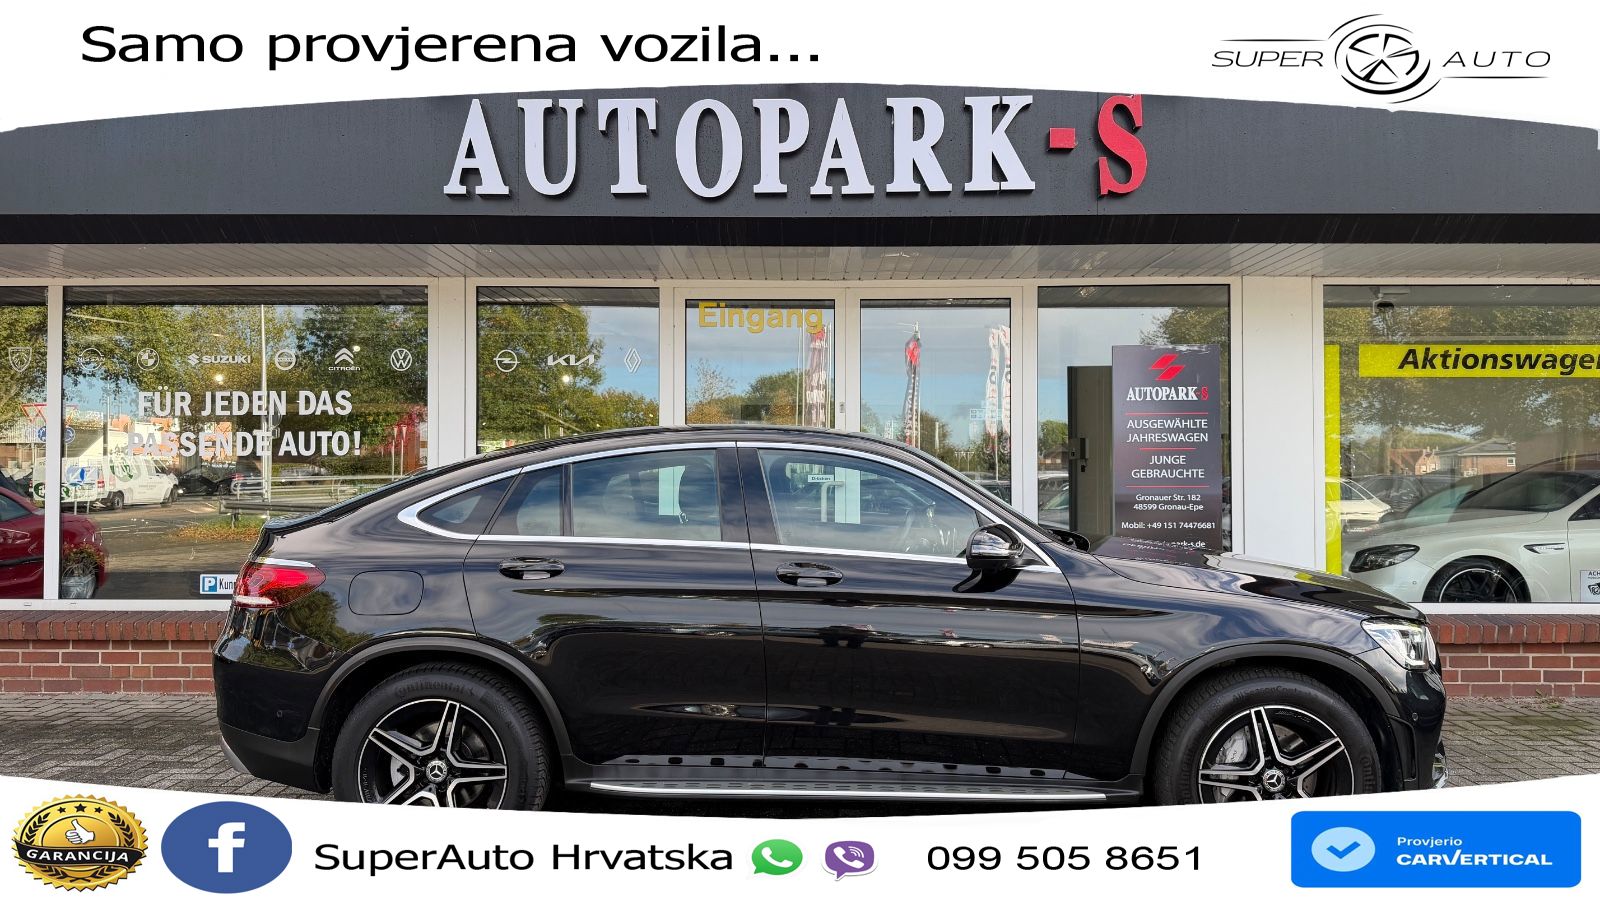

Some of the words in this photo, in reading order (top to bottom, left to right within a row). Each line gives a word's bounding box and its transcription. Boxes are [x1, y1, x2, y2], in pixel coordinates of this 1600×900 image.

[698, 300, 823, 334] Eingang
[202, 355, 251, 364] SUZUKI
[1126, 386, 1209, 401] AUTOPARK-S
[138, 385, 192, 416] FÜR
[201, 390, 287, 416] JEDEN
[298, 390, 353, 416] DAS
[1126, 417, 1209, 429] AUSGEWÄHLTE
[1126, 432, 1209, 443] JAHRESWAGEN
[127, 431, 272, 457] PASSENDE
[278, 430, 361, 457] AUTO!
[1149, 455, 1187, 465] JUNGE
[1131, 468, 1205, 479] GEBRAUCHTE
[1133, 503, 1158, 511] 48599
[1158, 503, 1204, 512] Gronau-Epe
[1121, 521, 1146, 529] Mobil:
[1147, 521, 1162, 529] +49
[1164, 521, 1177, 529] 151
